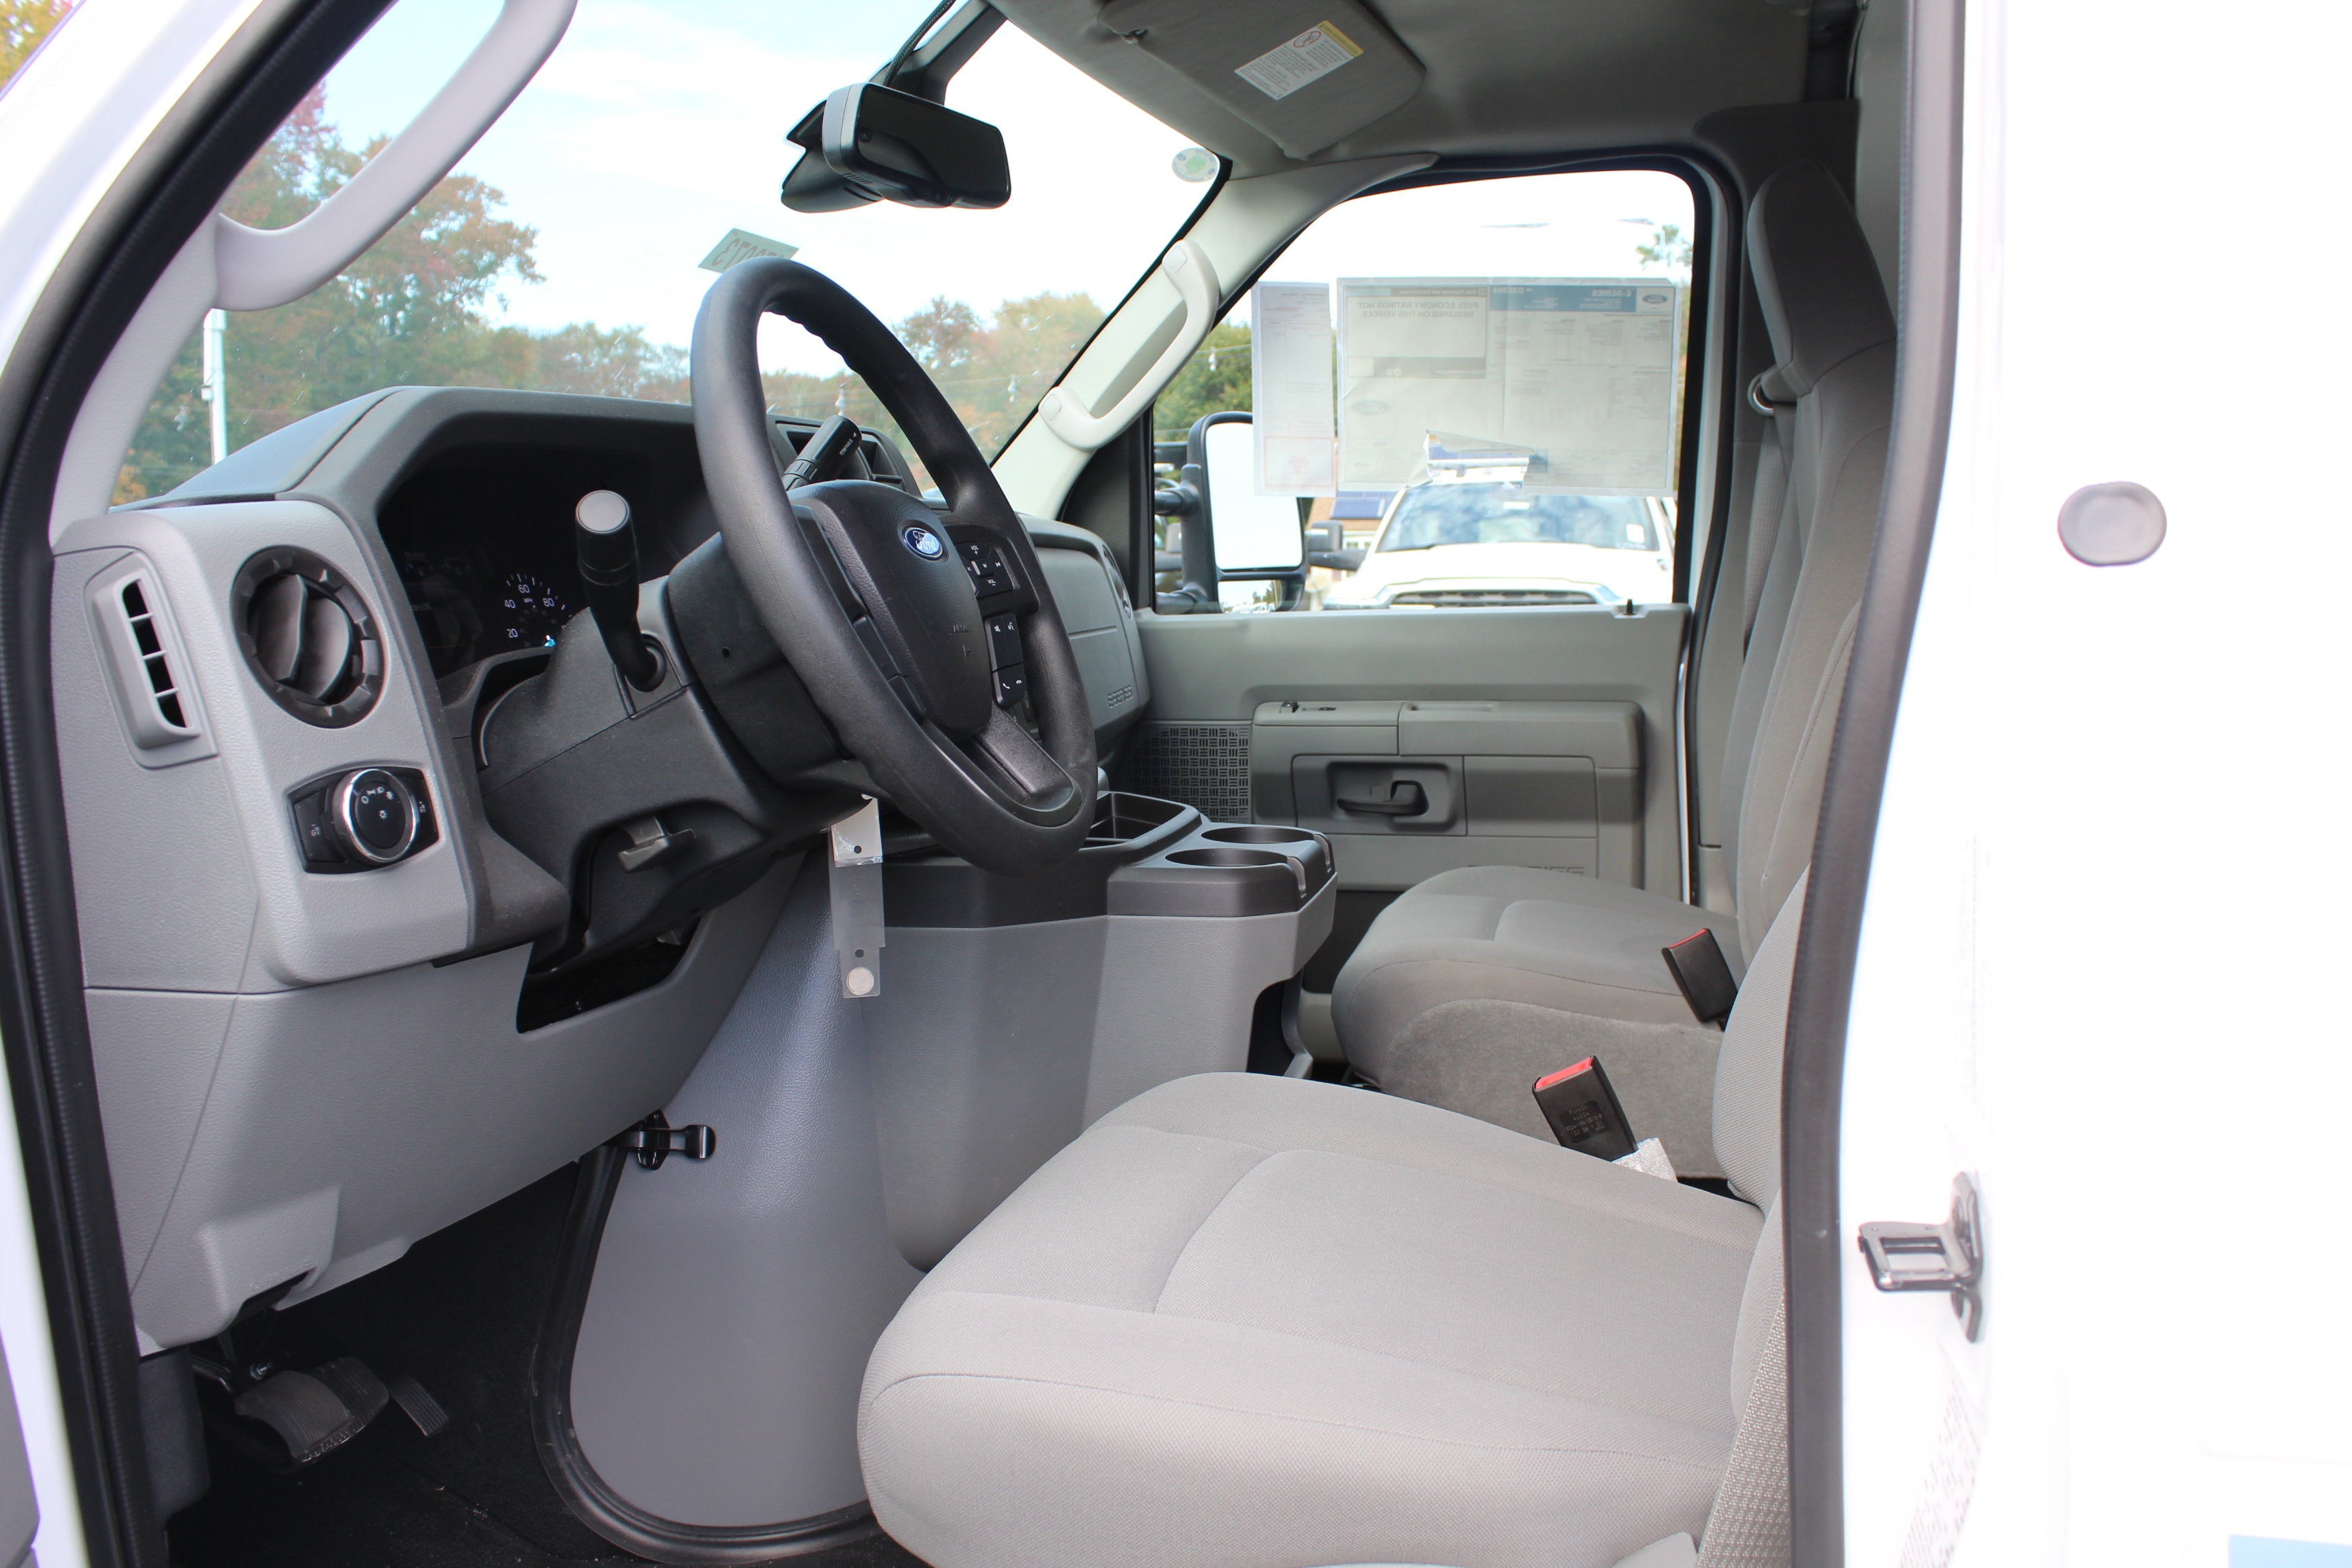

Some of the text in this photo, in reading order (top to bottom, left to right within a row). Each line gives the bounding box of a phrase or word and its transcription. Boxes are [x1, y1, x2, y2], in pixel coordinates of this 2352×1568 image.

[911, 529, 939, 552] Ford
[518, 584, 530, 593] 60
[504, 599, 516, 608] 40
[542, 598, 555, 607] 80
[506, 628, 518, 638] 20
